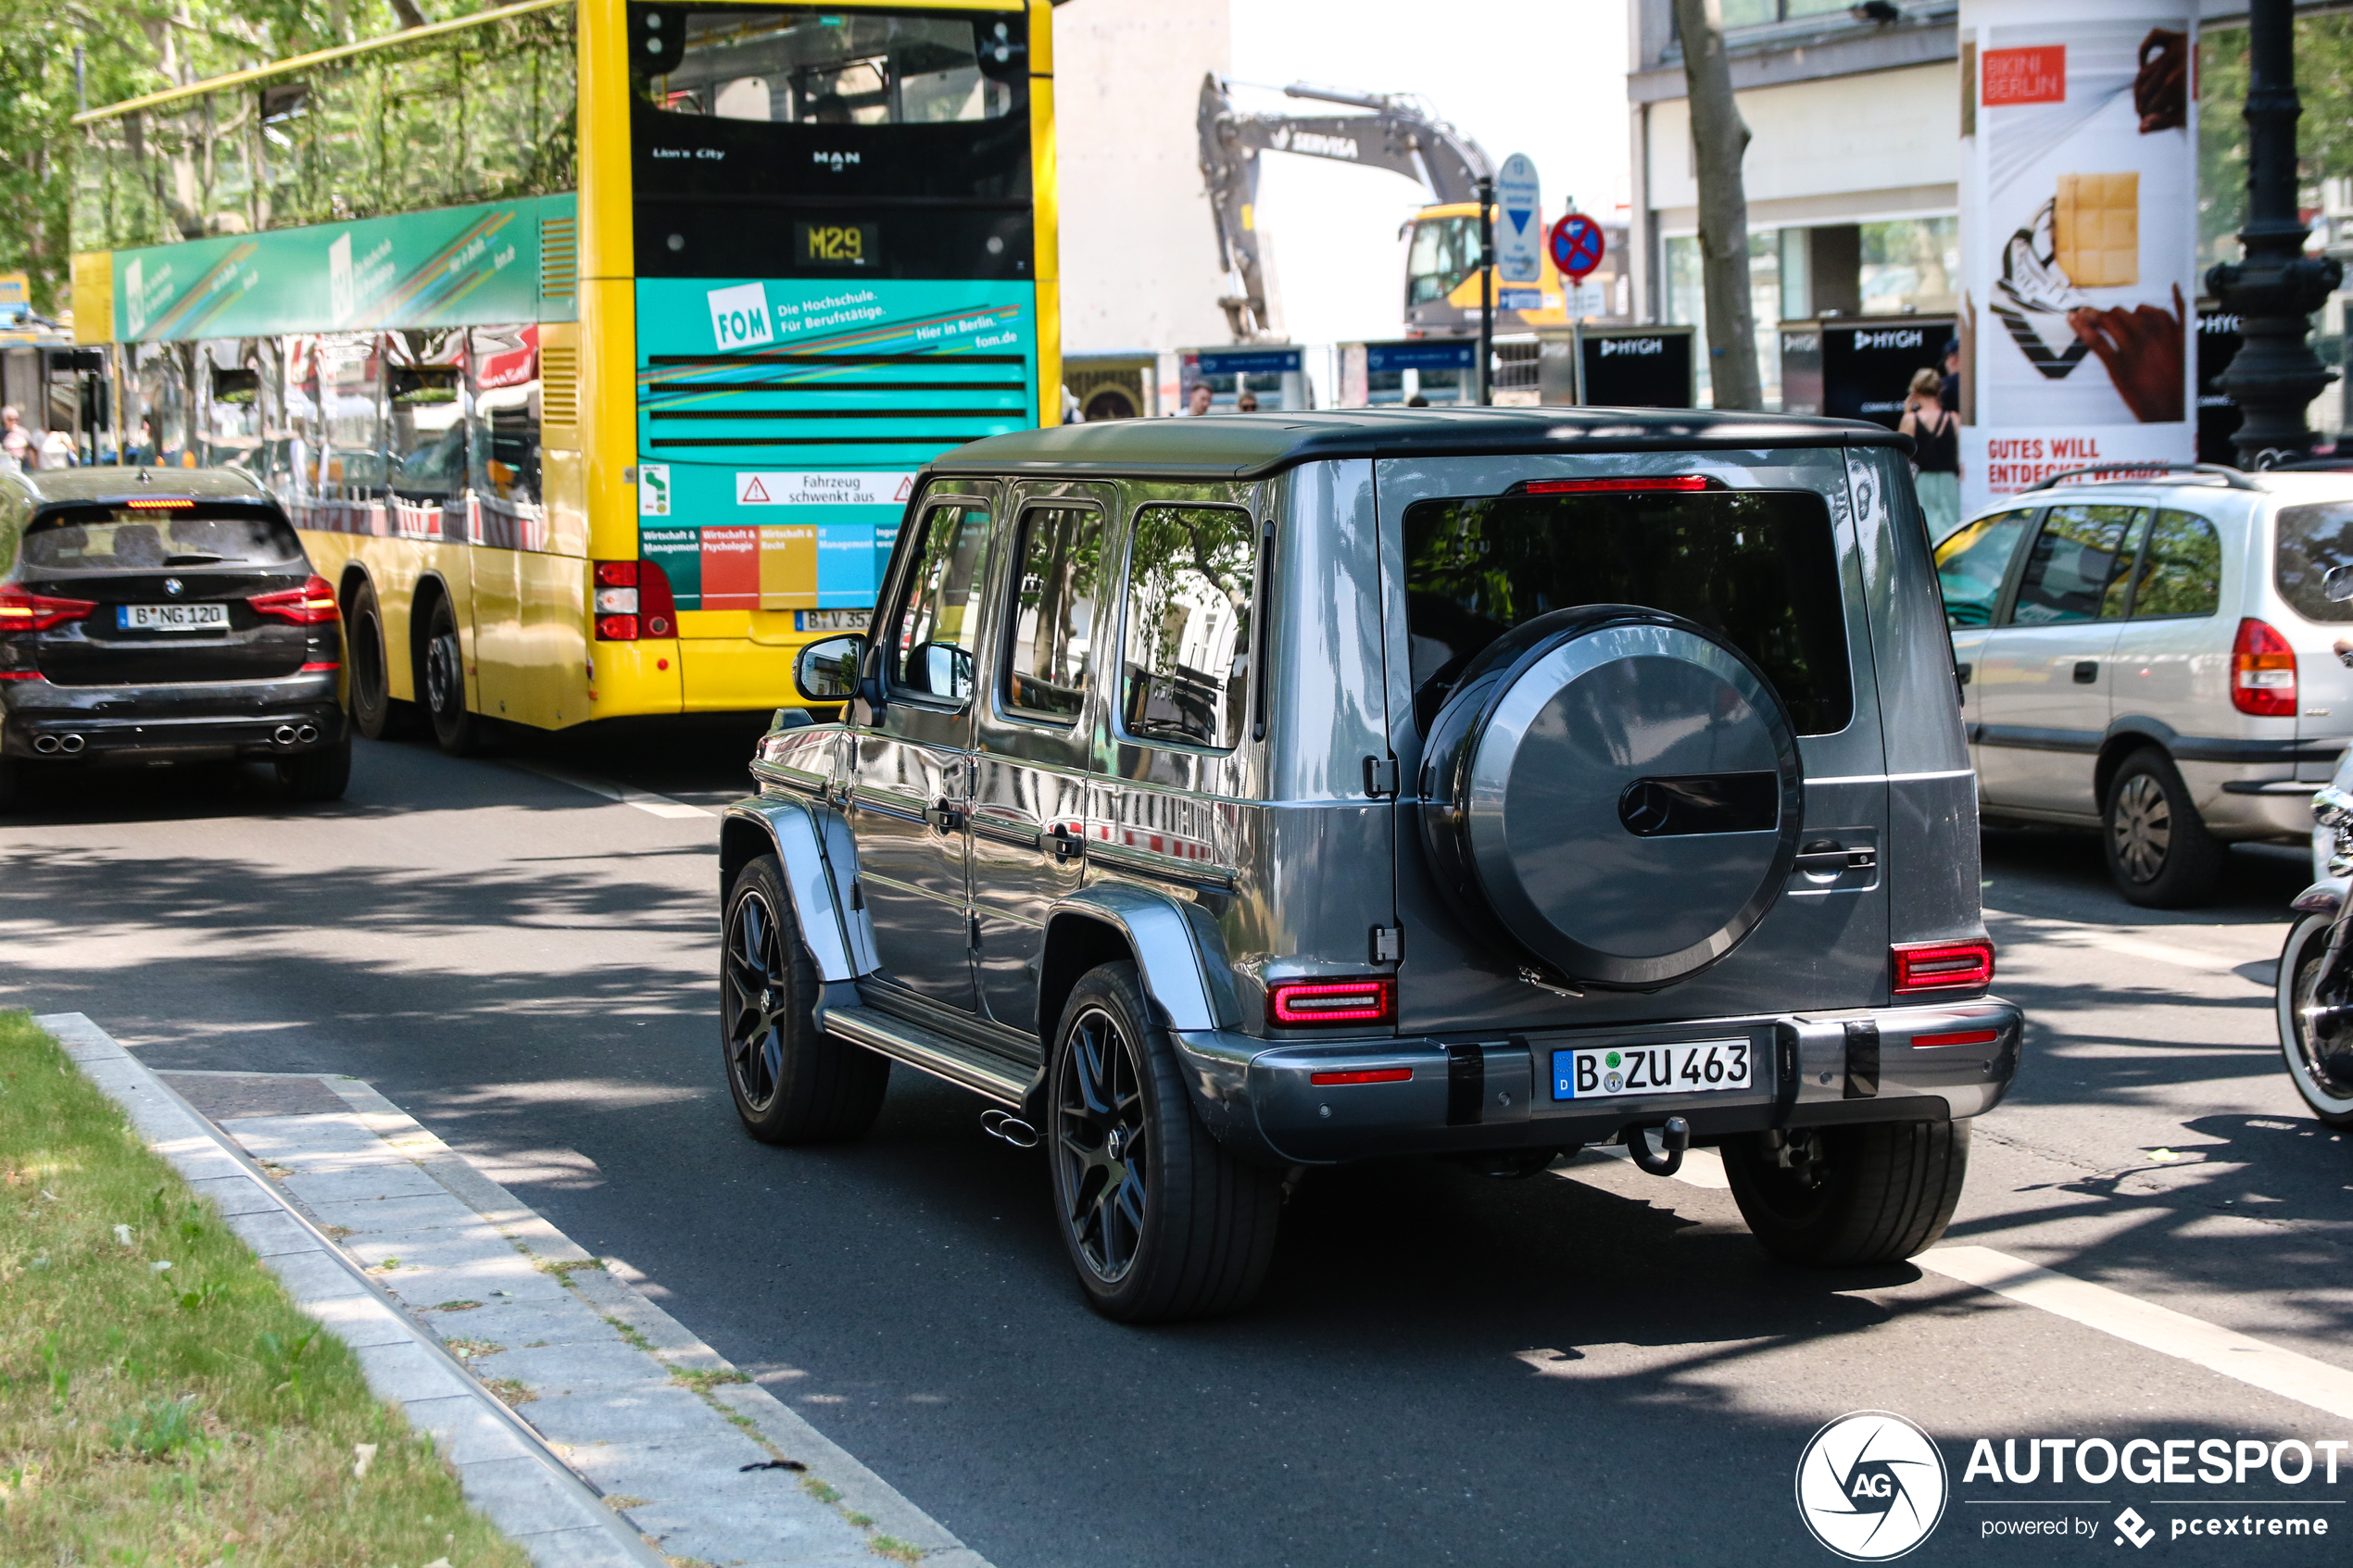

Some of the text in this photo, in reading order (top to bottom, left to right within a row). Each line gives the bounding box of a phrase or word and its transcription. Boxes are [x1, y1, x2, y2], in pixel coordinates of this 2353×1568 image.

[1987, 56, 2041, 75] BIKINI
[1987, 76, 2057, 99] BERLIN
[653, 148, 725, 159] Lion's City
[813, 152, 861, 163] MAN
[809, 227, 862, 258] M29
[777, 290, 878, 318] Die Hochschule.
[717, 306, 767, 344] FOM
[781, 306, 887, 333] Für Berufstätige.
[916, 316, 998, 341] Hier in Berlin.
[975, 332, 1018, 349] fom.de
[1617, 338, 1663, 355] HYGH
[1873, 329, 1923, 348] HYGH
[1989, 437, 2100, 459] GUTES WILL
[803, 475, 861, 491] Fahrzeug
[789, 489, 875, 503] schwenkt aus
[643, 530, 697, 541] Wirtschaft &
[701, 529, 756, 540] Wirtschaft &
[761, 529, 813, 538] Wirtschaft &
[643, 543, 700, 554] Management
[702, 541, 754, 553] Psychologie
[761, 541, 786, 550] Recht
[818, 540, 874, 551] Management
[136, 607, 220, 624] B NG 120
[809, 612, 819, 629] B
[831, 612, 841, 627] V
[1577, 1045, 1747, 1092] B ZU 463
[1560, 1079, 1568, 1091] D
